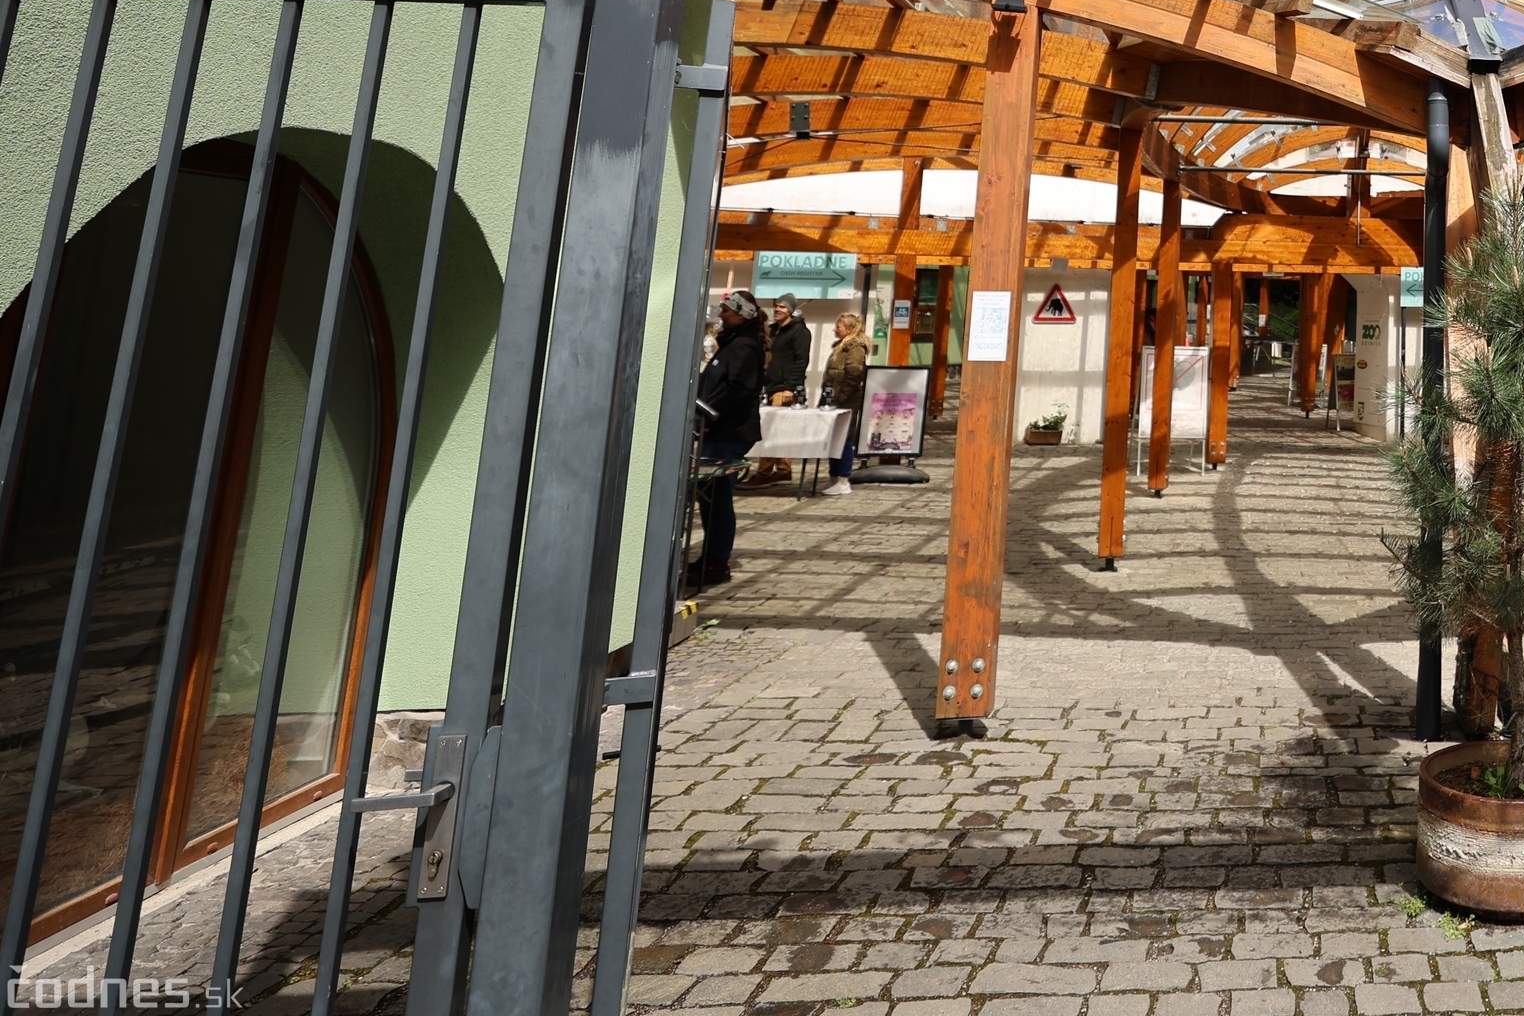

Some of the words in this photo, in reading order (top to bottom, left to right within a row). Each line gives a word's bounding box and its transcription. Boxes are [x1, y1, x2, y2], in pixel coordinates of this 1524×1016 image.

[760, 255, 847, 269] POKLADNE
[1362, 324, 1381, 340] ZOO
[973, 342, 1003, 350] PARKING
